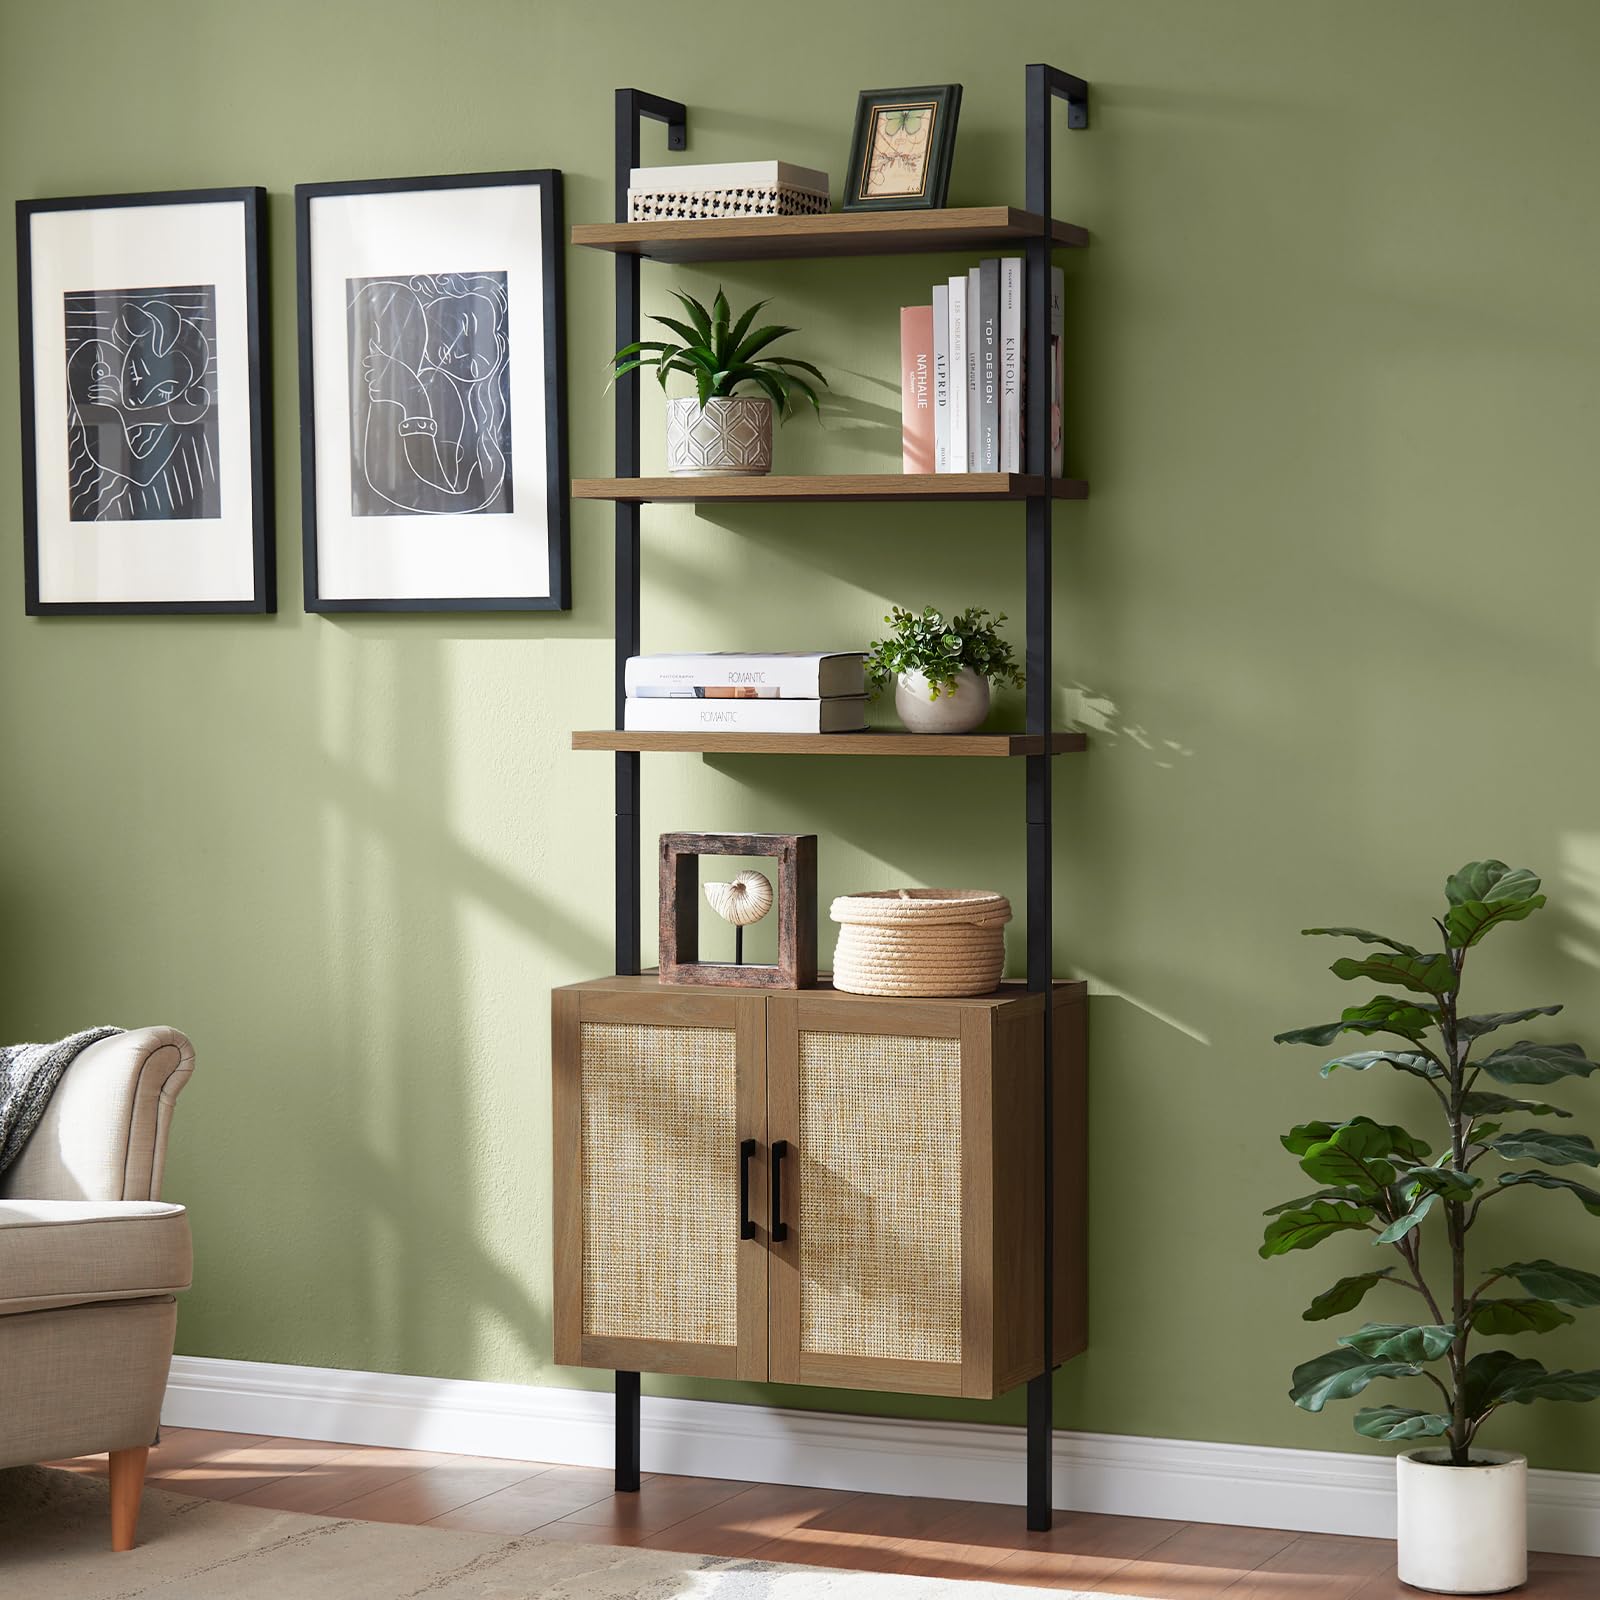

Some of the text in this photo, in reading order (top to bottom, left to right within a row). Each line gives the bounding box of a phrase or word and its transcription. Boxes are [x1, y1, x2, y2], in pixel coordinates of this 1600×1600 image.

[917, 354, 928, 409] NATHALIE
[937, 353, 947, 407] ALPRED
[1006, 337, 1015, 395] KINFOLK
[728, 671, 766, 684] ROMANTIC
[700, 711, 738, 723] ROMANTIC
